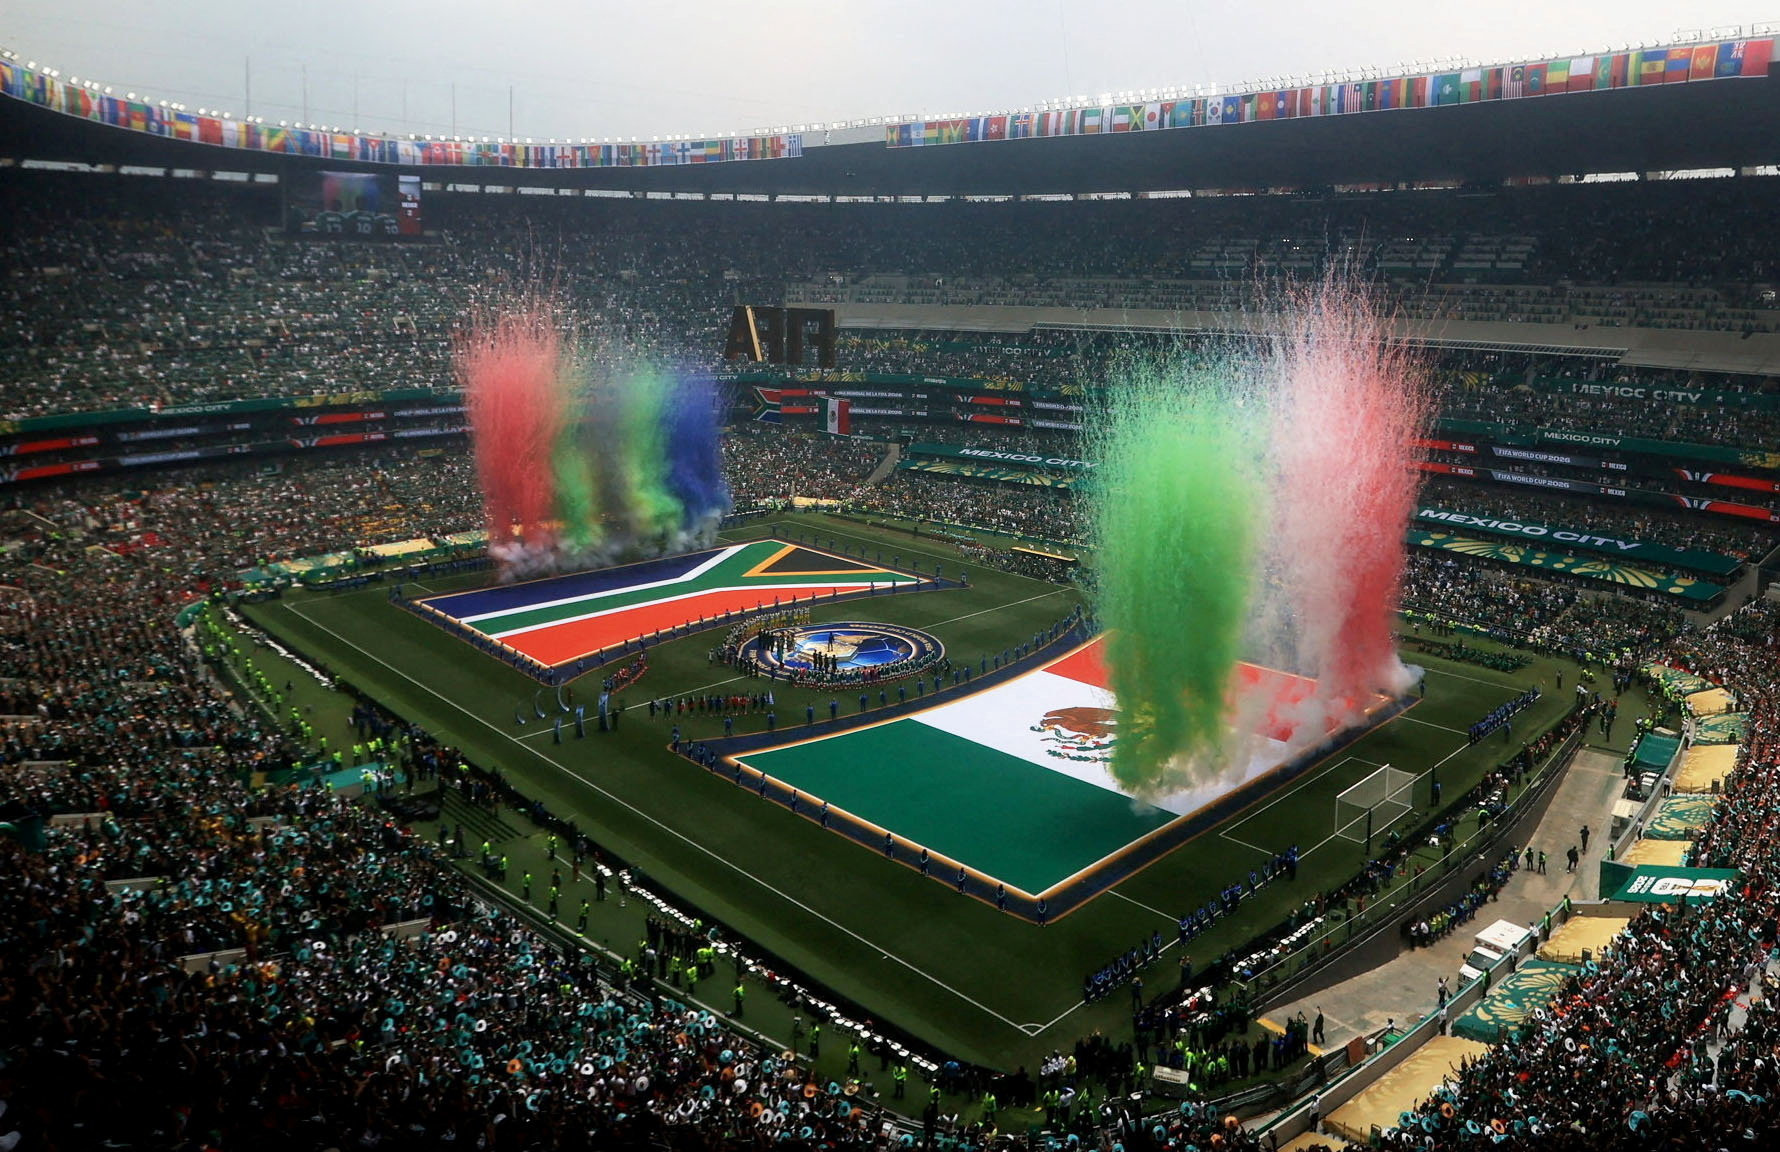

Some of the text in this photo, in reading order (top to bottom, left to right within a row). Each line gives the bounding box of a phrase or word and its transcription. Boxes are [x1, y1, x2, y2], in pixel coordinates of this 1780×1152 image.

[1544, 431, 1621, 446] MEXICO CITY
[959, 449, 1100, 468] MEXICO CITY
[1512, 451, 1534, 459] WORLD
[1548, 455, 1571, 463] 2026
[1609, 462, 1627, 471] MEXICO
[1511, 475, 1534, 483] WORLD
[1547, 480, 1570, 489] 2026
[1608, 488, 1626, 497] MEXICO
[1419, 509, 1642, 550] MEXICO CITY
